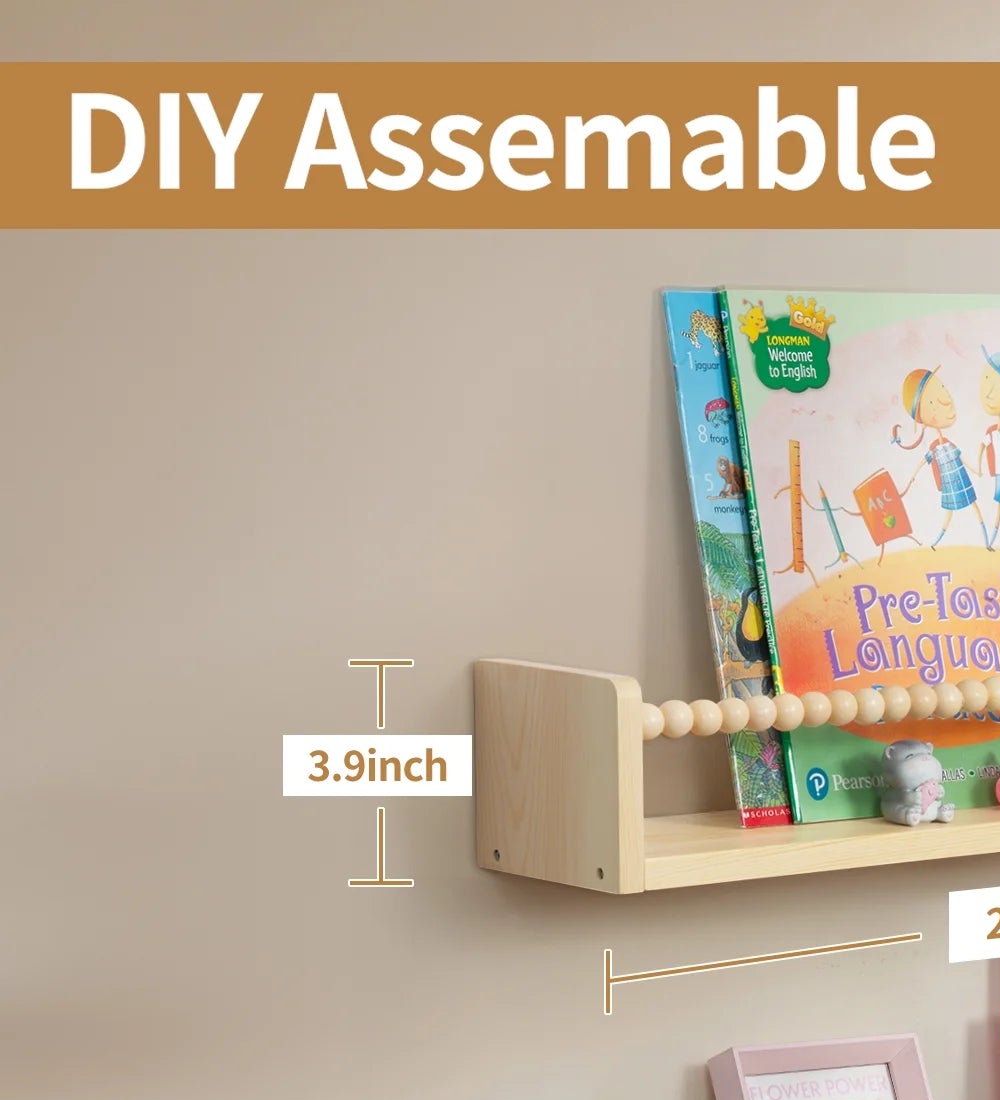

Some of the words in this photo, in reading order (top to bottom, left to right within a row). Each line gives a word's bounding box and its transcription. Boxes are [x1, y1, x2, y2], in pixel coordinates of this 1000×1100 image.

[793, 310, 825, 334] Gold
[766, 335, 810, 346] LONGMAN
[687, 351, 693, 369] 1
[695, 360, 720, 372] jaguar
[768, 347, 813, 362] Welcome
[769, 365, 780, 378] to
[781, 363, 817, 382] English
[698, 424, 707, 443] 8
[709, 434, 729, 445] frogs
[705, 473, 714, 491] 5
[824, 1075, 889, 1097] POWER
